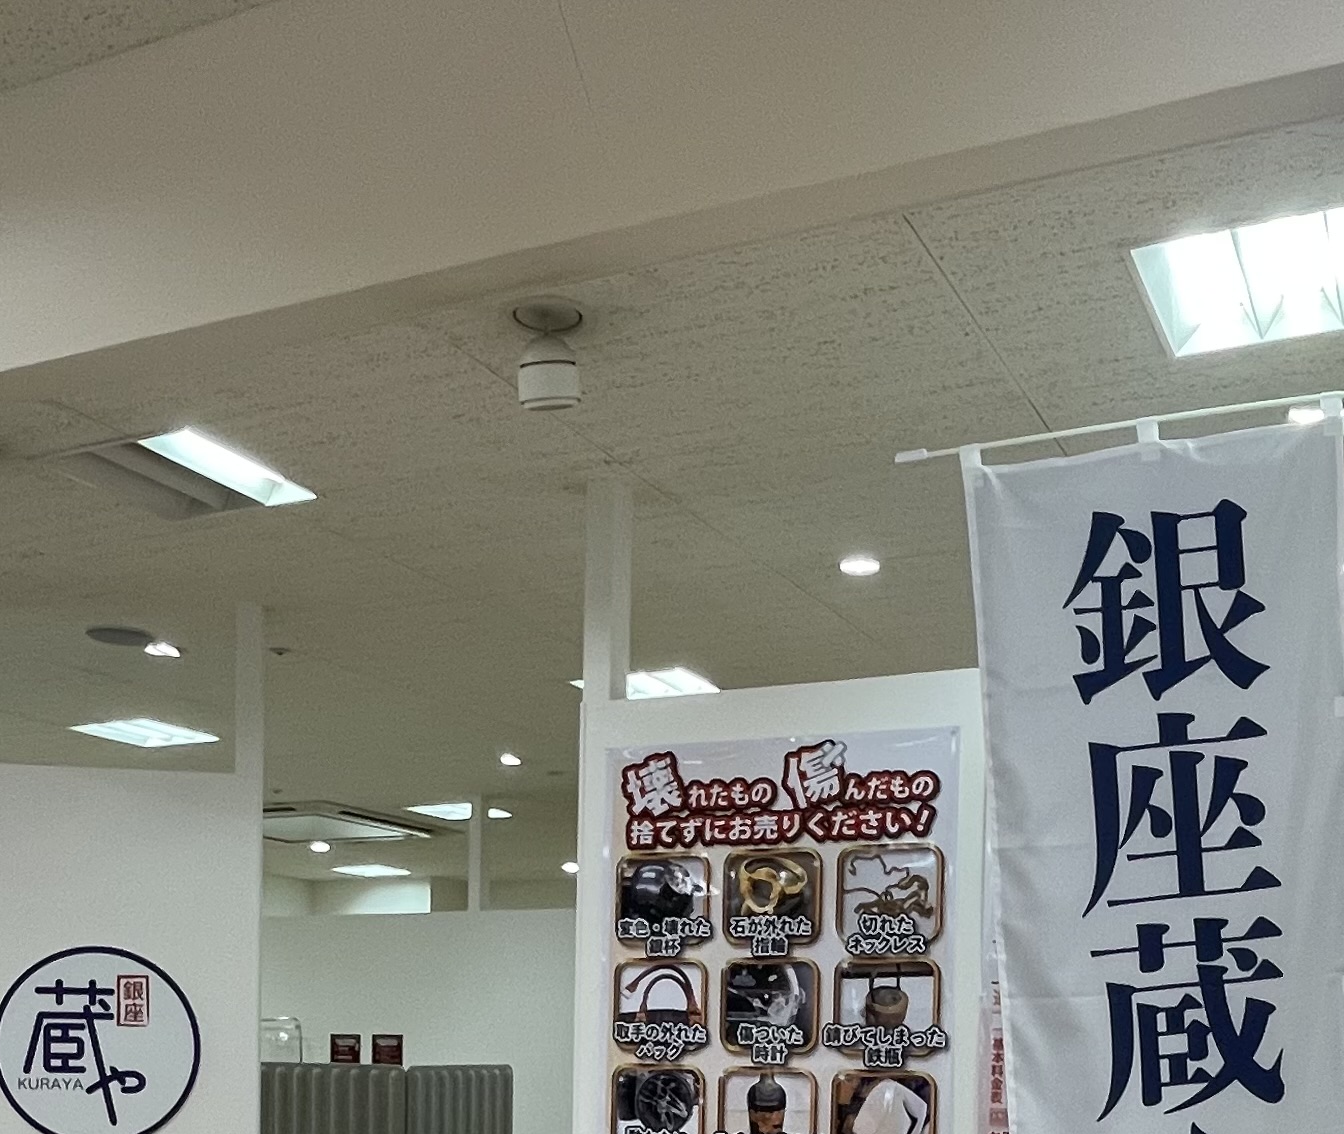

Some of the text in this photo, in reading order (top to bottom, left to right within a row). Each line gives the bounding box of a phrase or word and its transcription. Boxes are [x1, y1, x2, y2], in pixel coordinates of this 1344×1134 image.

[625, 741, 937, 816] 壊れたもの 傷んだもの
[629, 808, 933, 847] 捨てずにお売りください!
[729, 915, 812, 937] 石が外れた
[858, 915, 915, 935] 切れた
[847, 935, 926, 954] ネックレス
[122, 980, 145, 1023] 銀座
[614, 1022, 708, 1043] 取手の外れた
[752, 1044, 788, 1064] 時計
[17, 1076, 85, 1092] KURAYA
